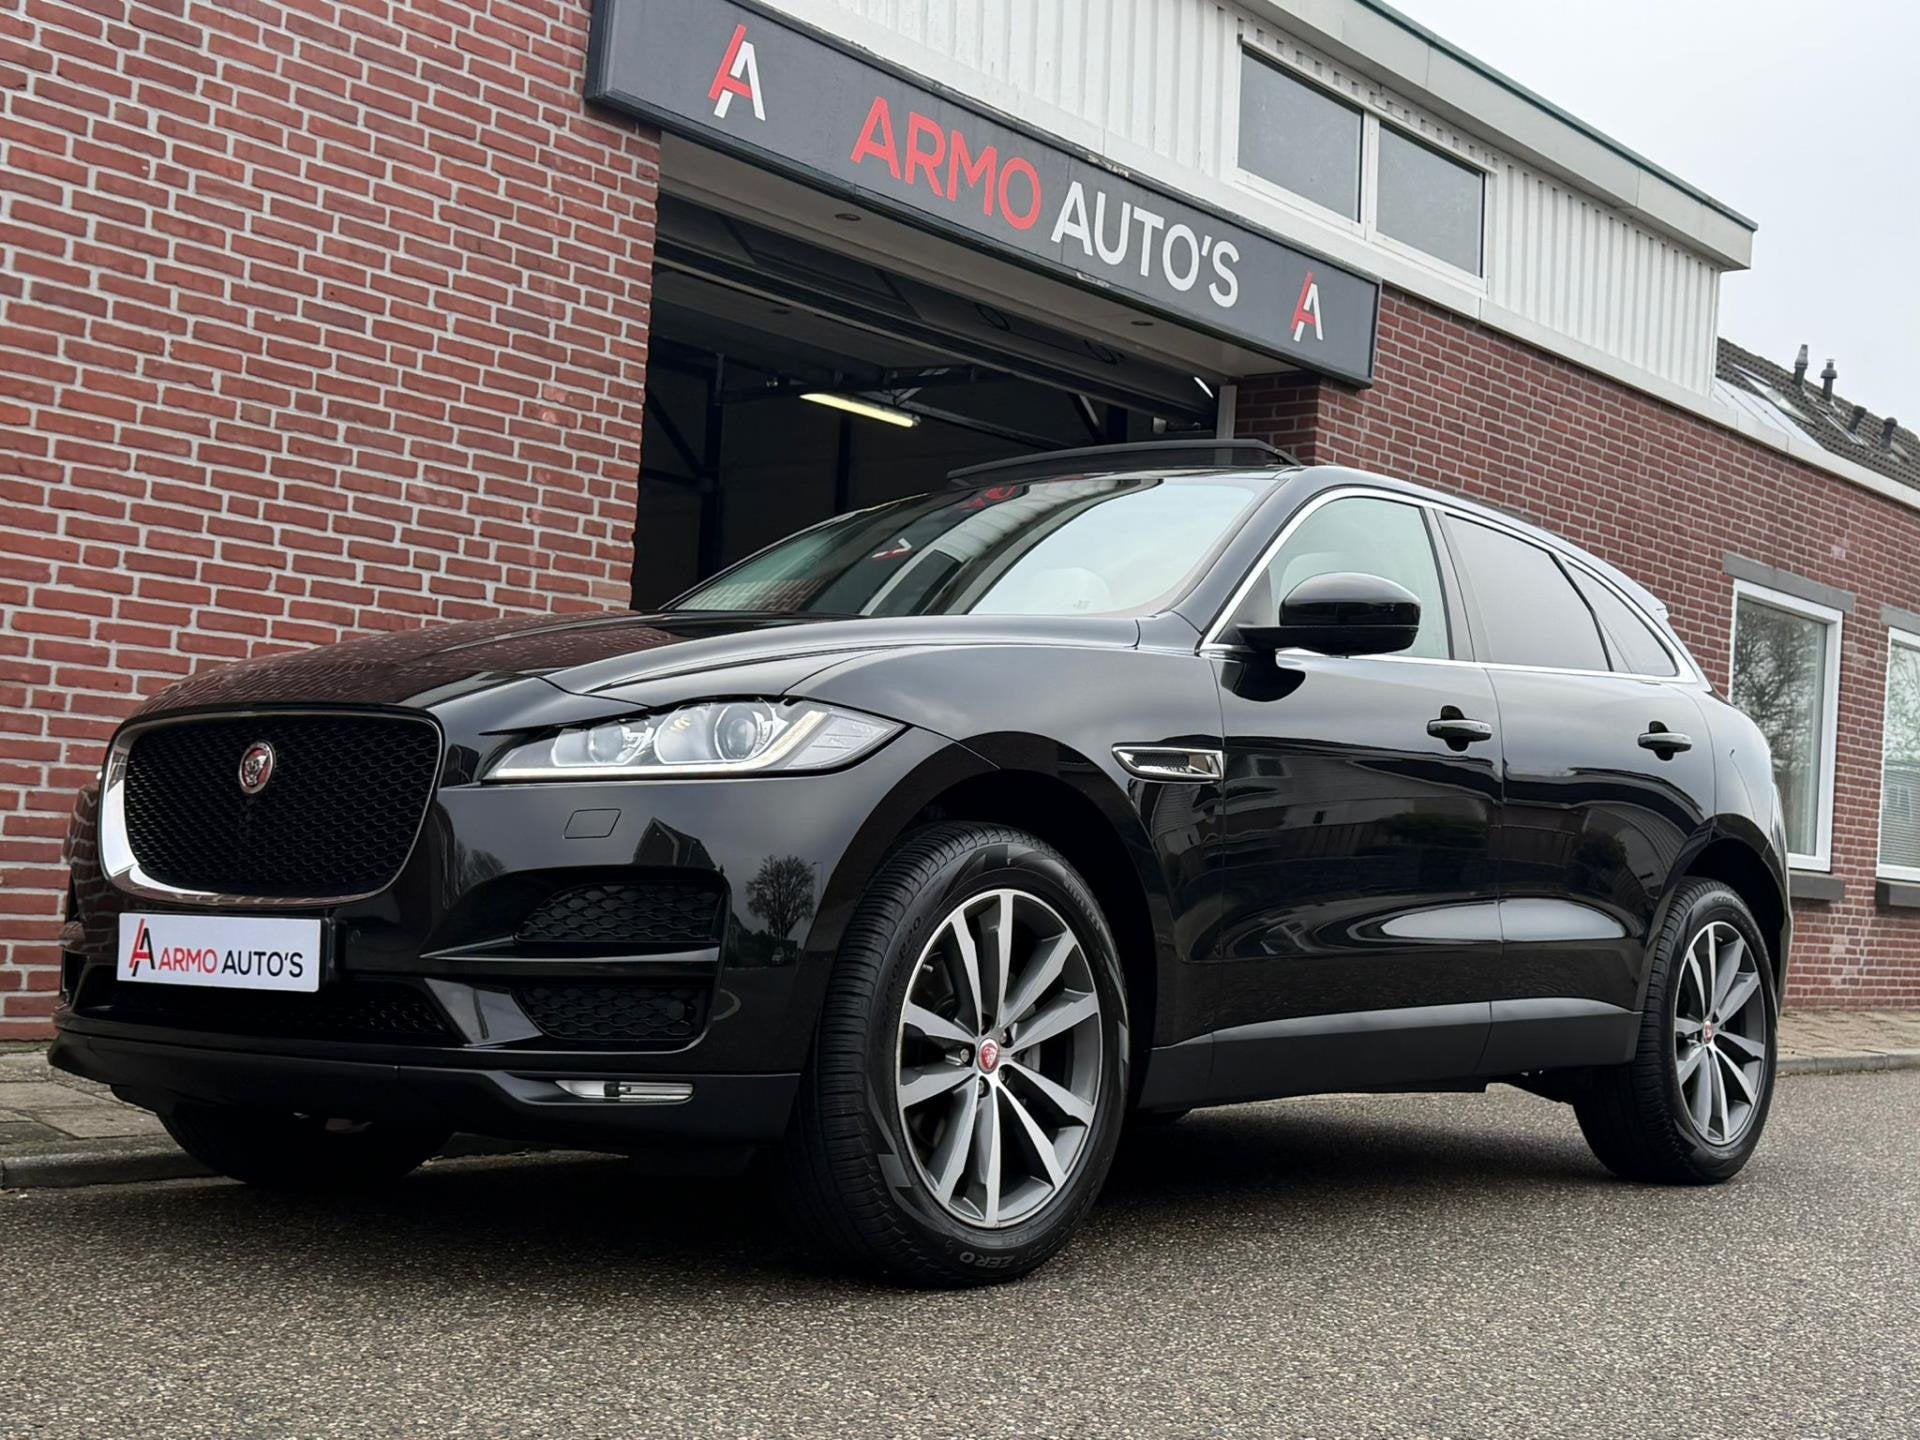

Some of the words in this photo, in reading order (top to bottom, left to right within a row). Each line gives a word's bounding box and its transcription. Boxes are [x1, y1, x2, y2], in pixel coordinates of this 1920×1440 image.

[851, 96, 1041, 230] ARMO
[1051, 181, 1241, 309] AUTO'S
[158, 948, 218, 974] ARMO
[221, 950, 304, 978] AUTO'S
[960, 1251, 1016, 1269] ZERO
